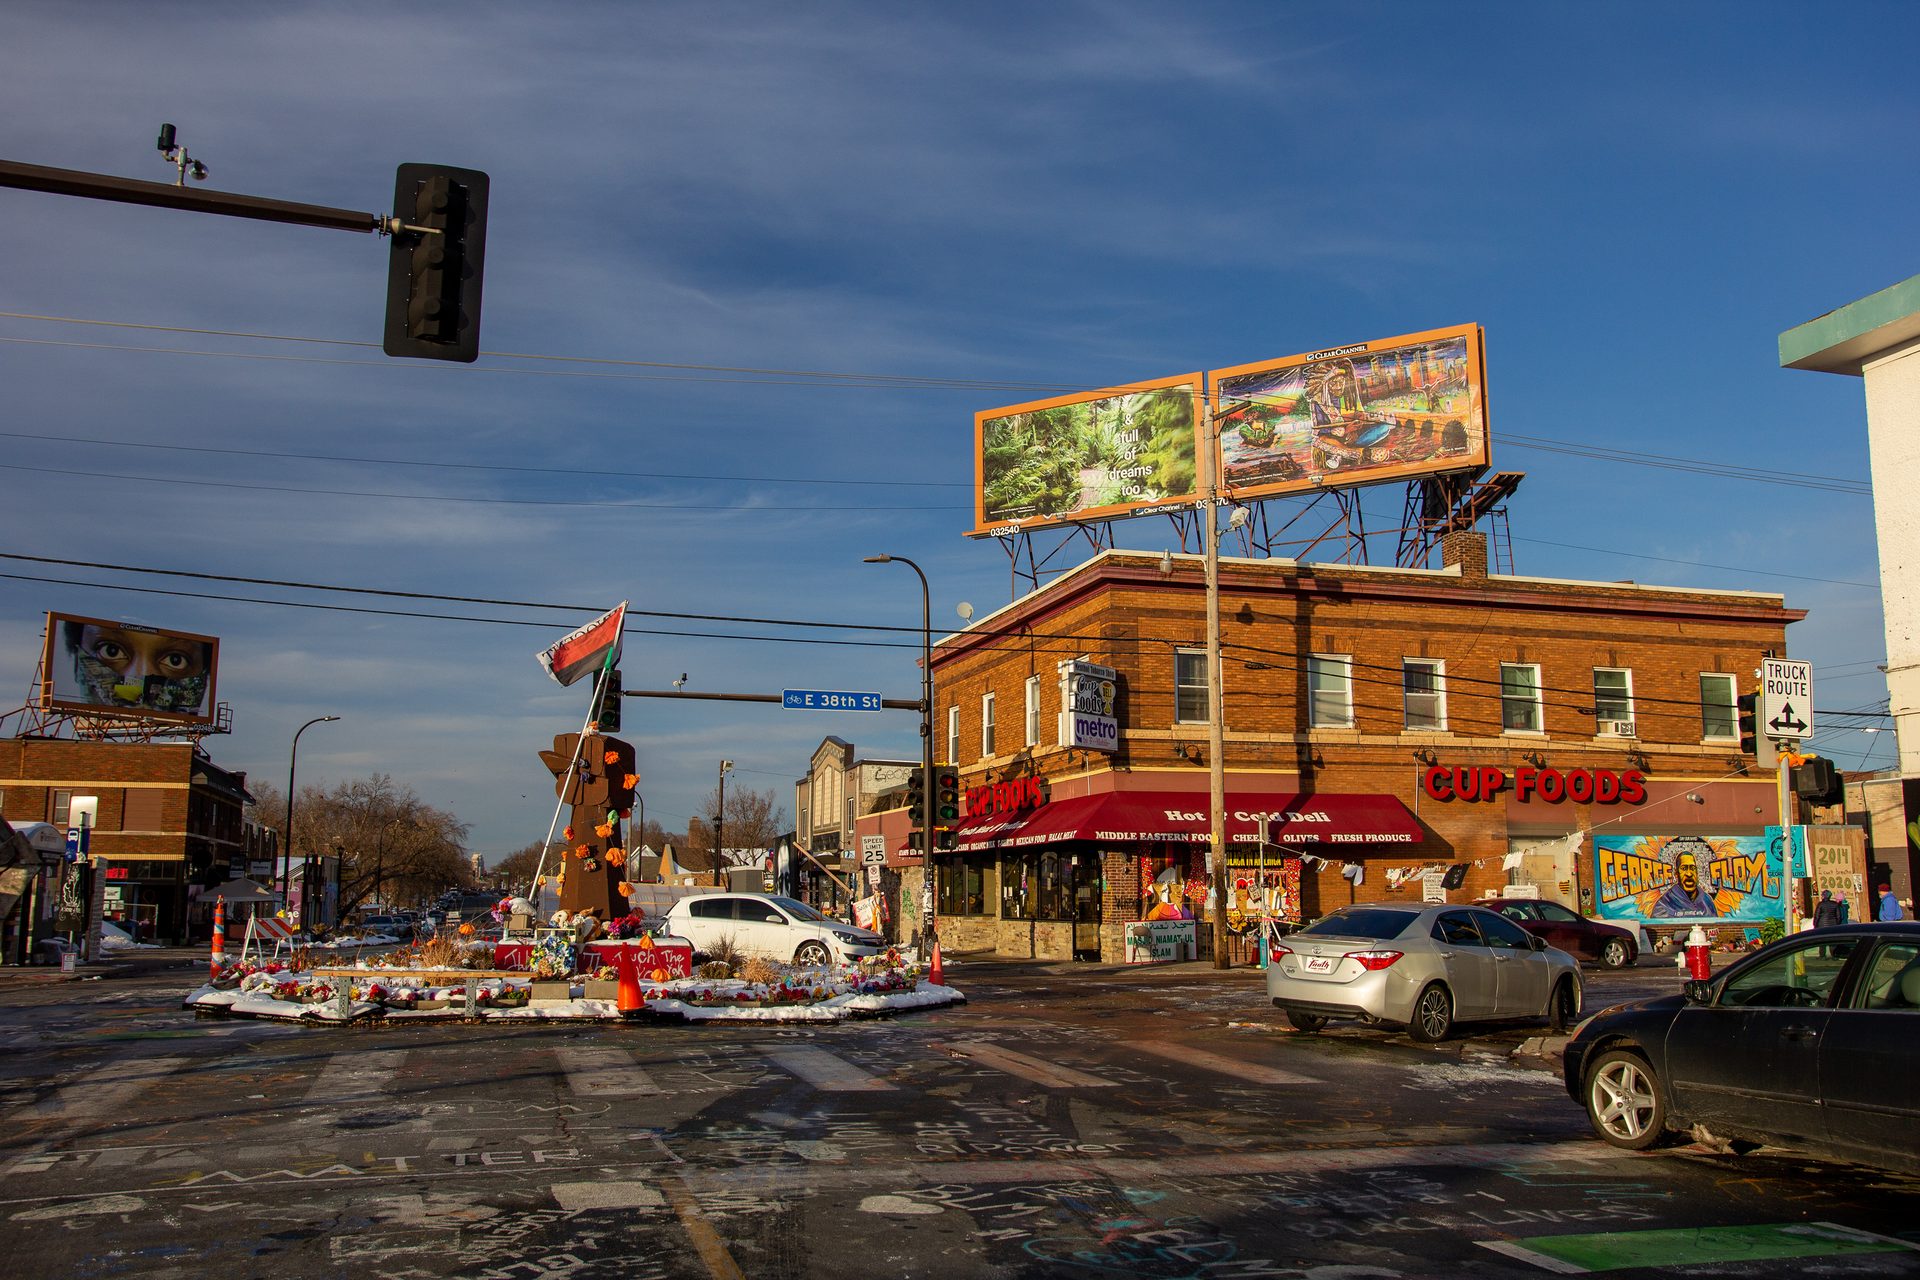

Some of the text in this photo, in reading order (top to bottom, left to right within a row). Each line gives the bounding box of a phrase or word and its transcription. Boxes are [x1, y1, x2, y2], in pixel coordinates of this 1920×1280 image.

[1124, 413, 1134, 425] &
[1120, 428, 1139, 444] full
[1124, 448, 1137, 460] of
[1108, 464, 1153, 481] dreams
[1121, 484, 1141, 496] too
[1158, 504, 1180, 512] Channel
[990, 525, 1020, 537] 032540
[1768, 664, 1806, 680] TRUCK
[1076, 674, 1099, 699] Cup
[1768, 680, 1807, 696] ROUTE
[805, 694, 878, 708] E 38th St
[1074, 692, 1103, 714] Foods
[1076, 717, 1117, 741] metro
[1424, 765, 1645, 803] CUP FOODS
[965, 775, 1043, 817] CUP FOODS
[1164, 811, 1206, 821] Hot
[1286, 811, 1332, 822] Deli
[1034, 834, 1047, 844] FOOD
[1095, 831, 1137, 840] MIDDLE
[1139, 832, 1189, 841] EASTERN
[1191, 833, 1214, 842] FOO
[1283, 834, 1320, 842] OLIVES
[1331, 834, 1363, 842] FRESH
[1366, 834, 1412, 842] PRODUCE
[864, 850, 884, 862] 25
[1818, 847, 1849, 864] 2014
[1599, 847, 1674, 903] GEORGE
[1820, 876, 1852, 889] 2020
[1184, 933, 1194, 942] UL
[660, 949, 685, 965] The
[1151, 948, 1171, 957] SLAM
[1467, 1203, 1660, 1226] LIVES
